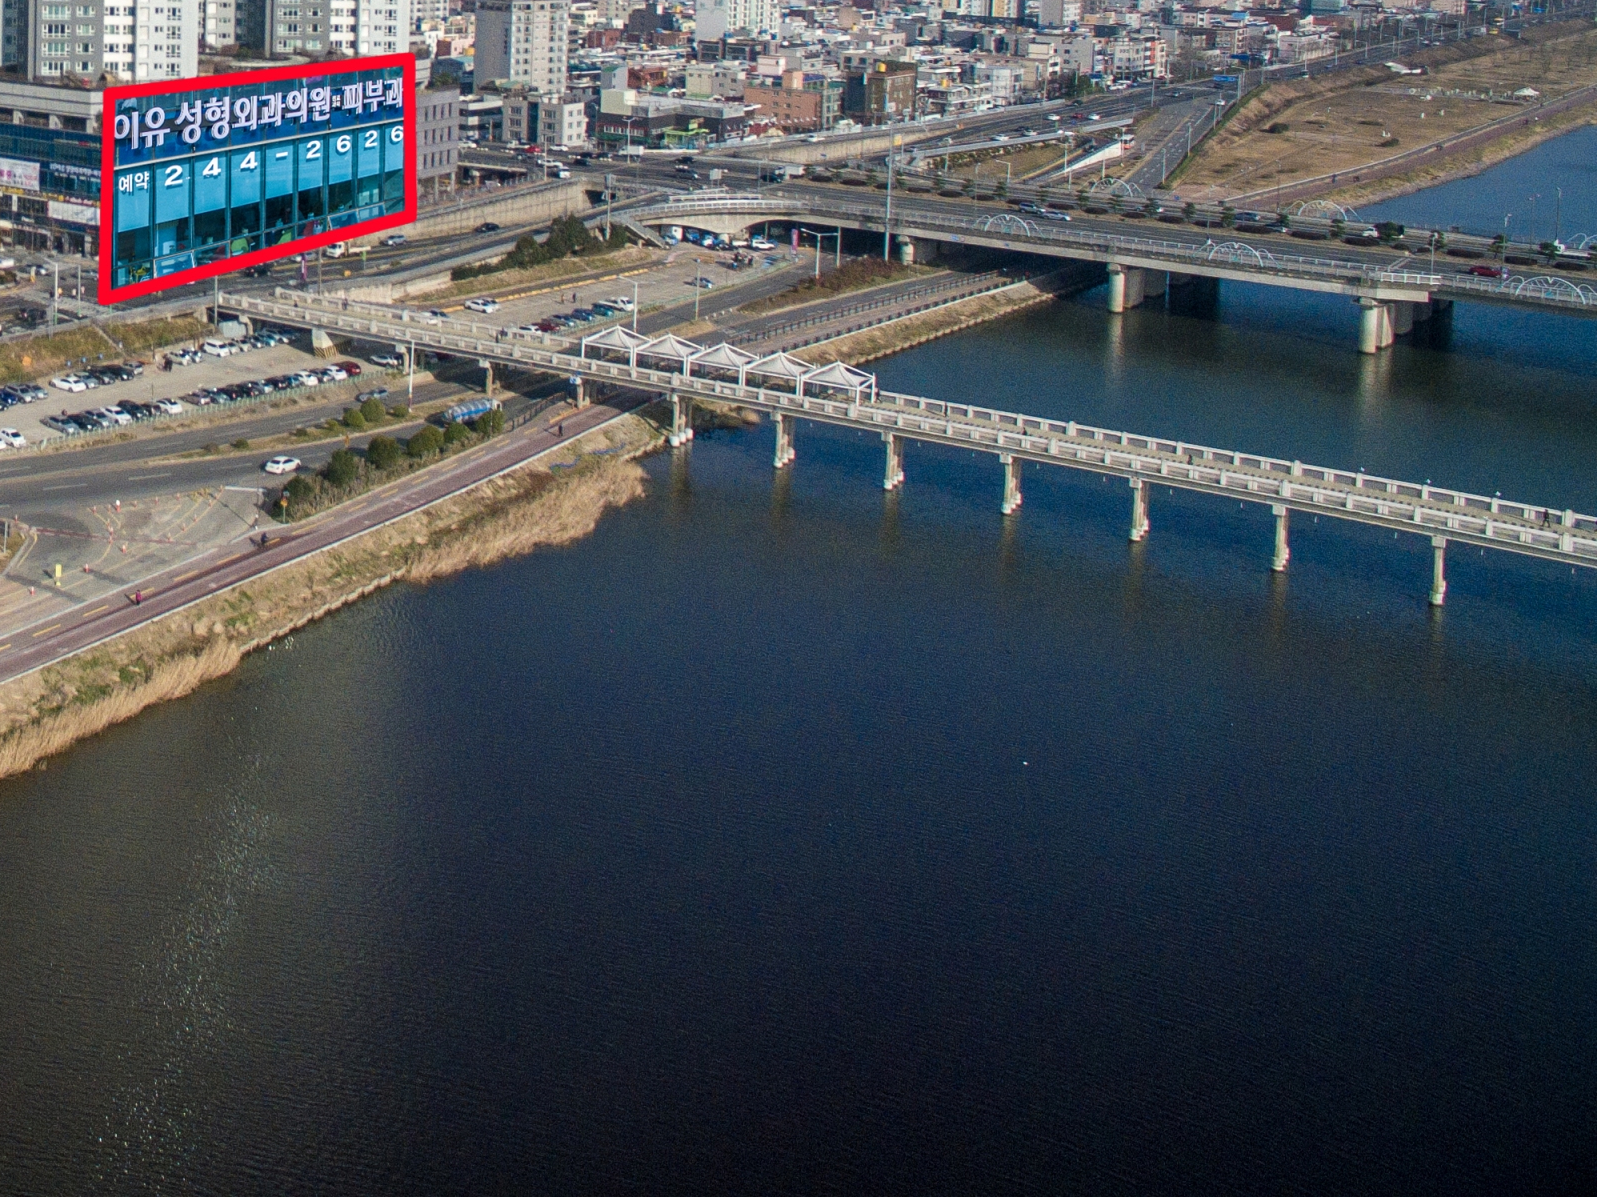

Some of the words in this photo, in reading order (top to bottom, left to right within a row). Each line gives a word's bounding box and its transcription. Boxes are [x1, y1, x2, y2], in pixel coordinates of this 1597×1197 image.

[114, 107, 171, 150] 이유
[174, 86, 331, 144] 성형외과의원
[342, 77, 403, 115] 피부과
[119, 171, 150, 192] 예약
